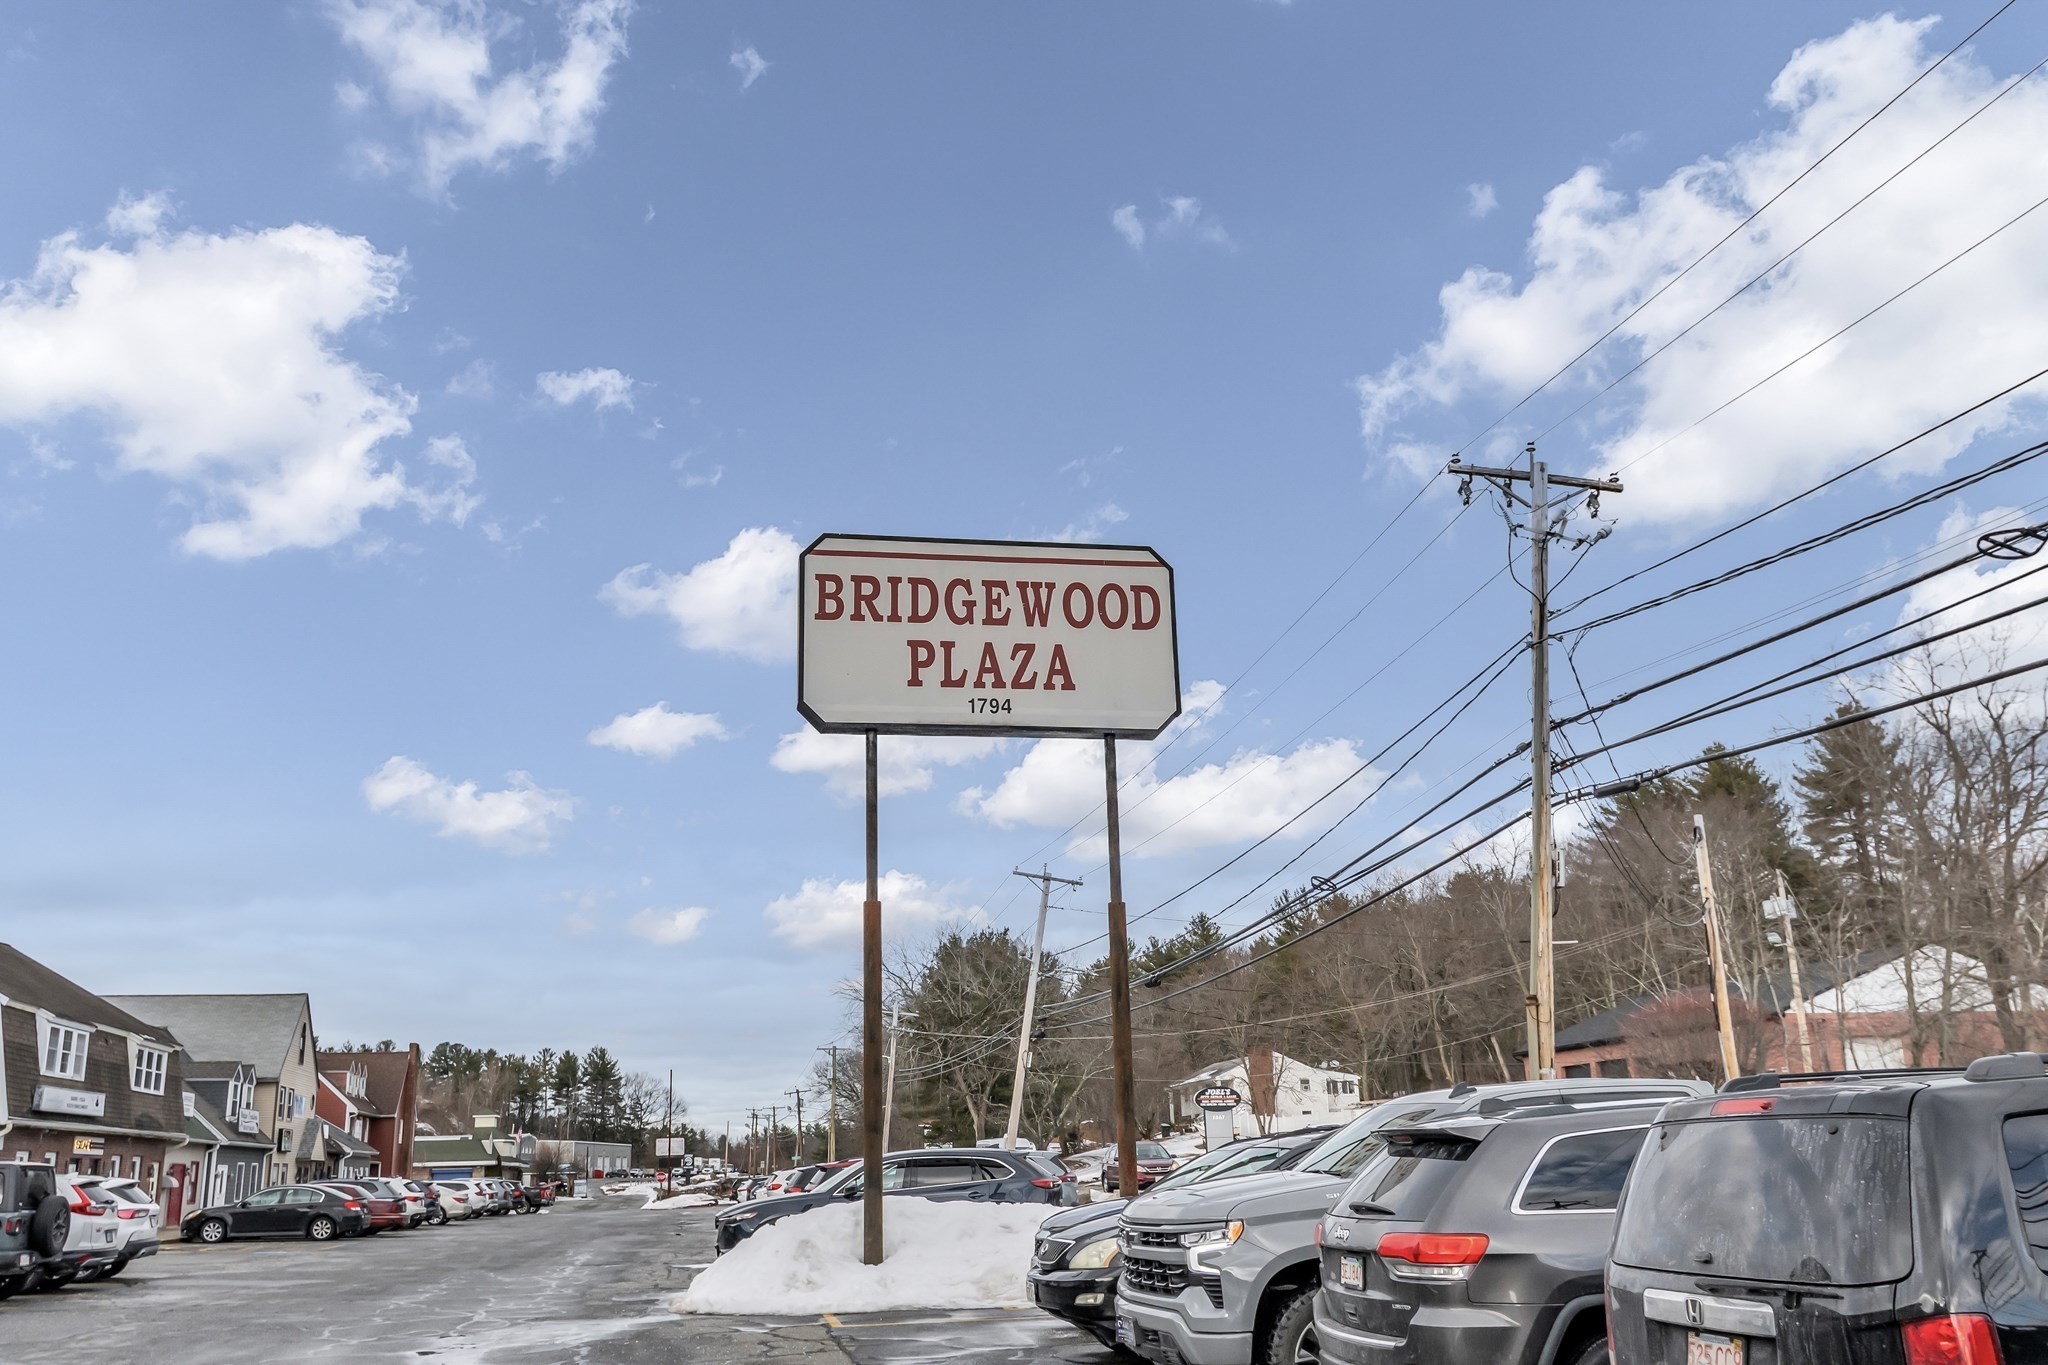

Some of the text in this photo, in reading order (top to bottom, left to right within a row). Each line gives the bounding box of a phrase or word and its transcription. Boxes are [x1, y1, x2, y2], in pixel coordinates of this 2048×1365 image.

[814, 573, 1161, 630] BRIDGEWOOD
[906, 639, 1076, 691] PLAZA
[967, 698, 1012, 714] 1794
[1335, 1225, 1350, 1242] Jeep
